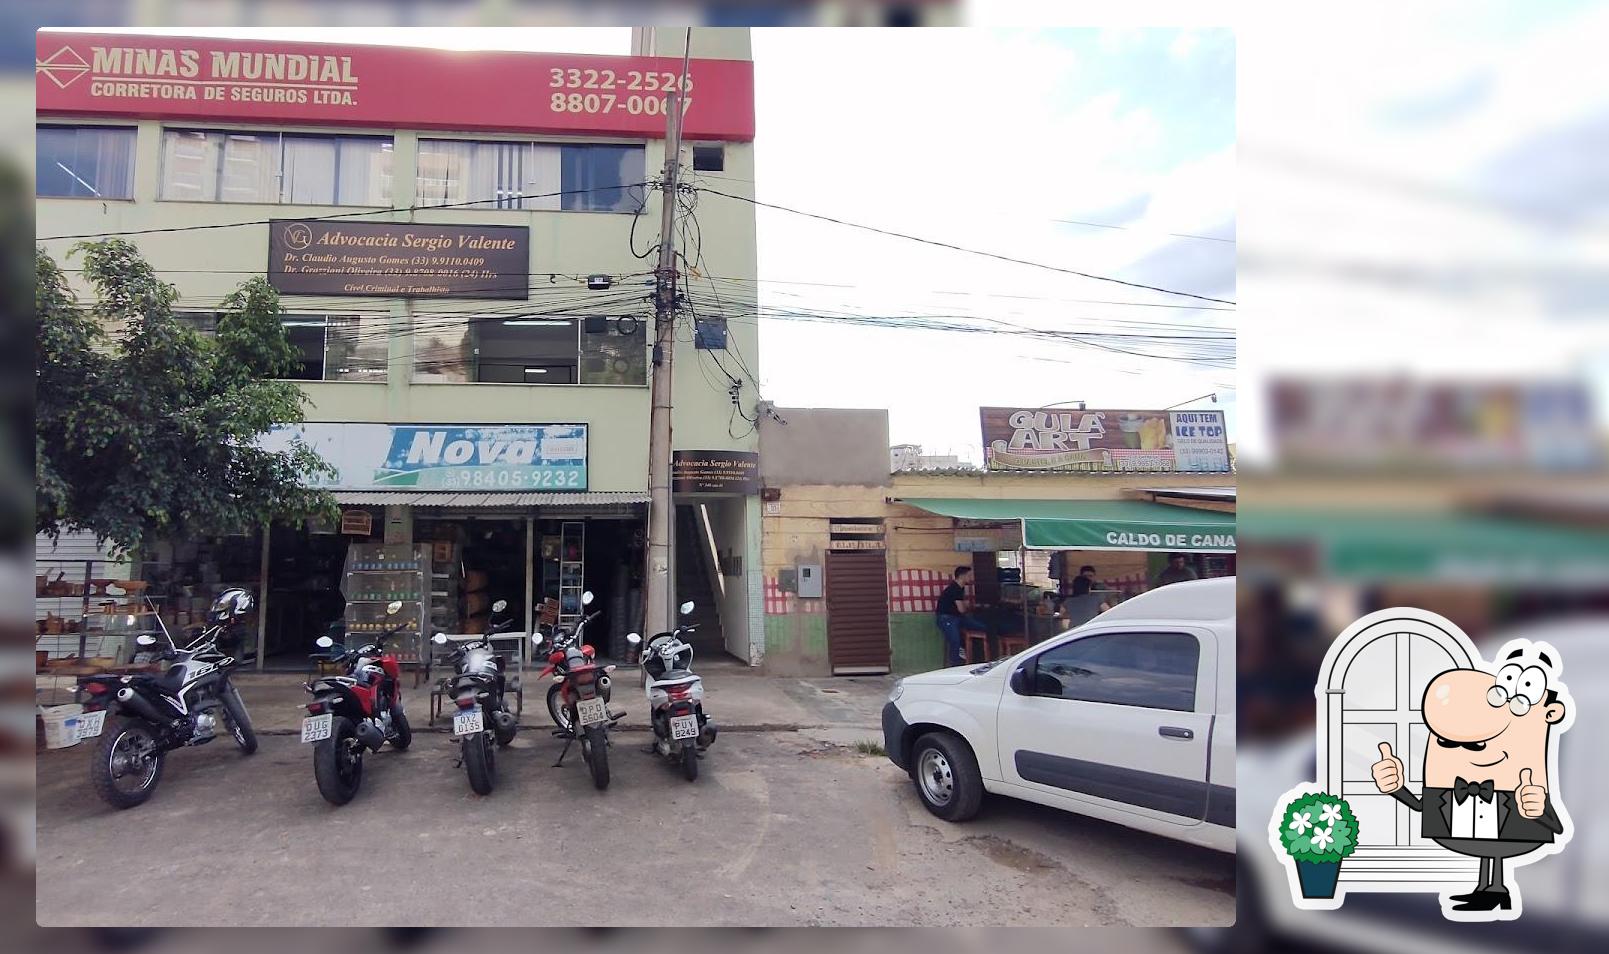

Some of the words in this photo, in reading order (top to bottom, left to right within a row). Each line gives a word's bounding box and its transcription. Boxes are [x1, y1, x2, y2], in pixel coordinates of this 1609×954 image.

[90, 46, 200, 78] MINAS
[210, 51, 358, 83] MUNDIAL
[549, 68, 694, 92] 3322-2526
[91, 82, 197, 100] CORRETORA
[204, 86, 225, 100] DE
[231, 87, 307, 104] SEGUROS
[313, 90, 358, 106] LTDA.
[317, 231, 398, 247] Advocacia
[402, 234, 453, 250] Sergio
[458, 235, 516, 249] Valente
[284, 252, 299, 262] Dr.
[302, 253, 338, 263] Claudio
[340, 254, 377, 265] Augusto
[379, 255, 409, 265] Gomes
[411, 256, 429, 266] (33)
[284, 264, 298, 273] Dr.
[1009, 411, 1106, 433] GULA
[1176, 413, 1198, 424] AQUI
[1199, 414, 1218, 423] TEM
[1008, 428, 1104, 451] ART
[1175, 426, 1196, 437] ICE
[1198, 426, 1222, 437] TOP
[406, 431, 538, 465] Nova
[1106, 531, 1161, 546] CALDO
[1165, 534, 1187, 546] DE
[1191, 534, 1236, 547] CANA
